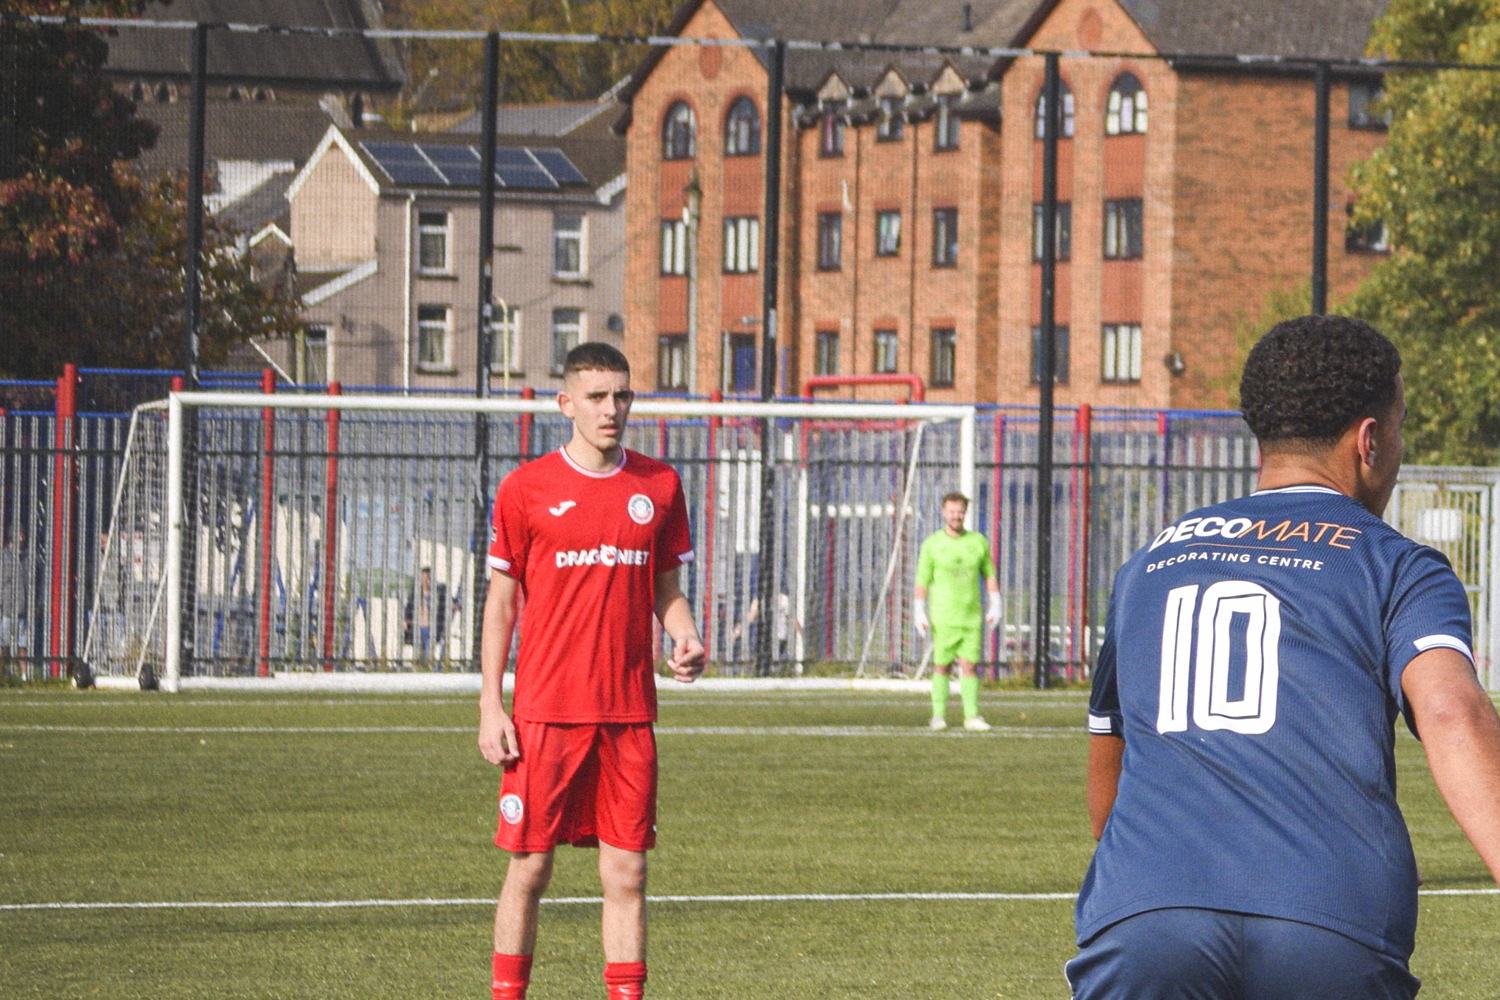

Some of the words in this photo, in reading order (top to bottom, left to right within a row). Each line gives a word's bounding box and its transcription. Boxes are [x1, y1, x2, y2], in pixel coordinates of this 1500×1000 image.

[1149, 516, 1362, 552] DECOMATE
[1147, 552, 1250, 573] DECORATING
[1257, 555, 1324, 571] CENTRE
[1157, 580, 1280, 735] 10
